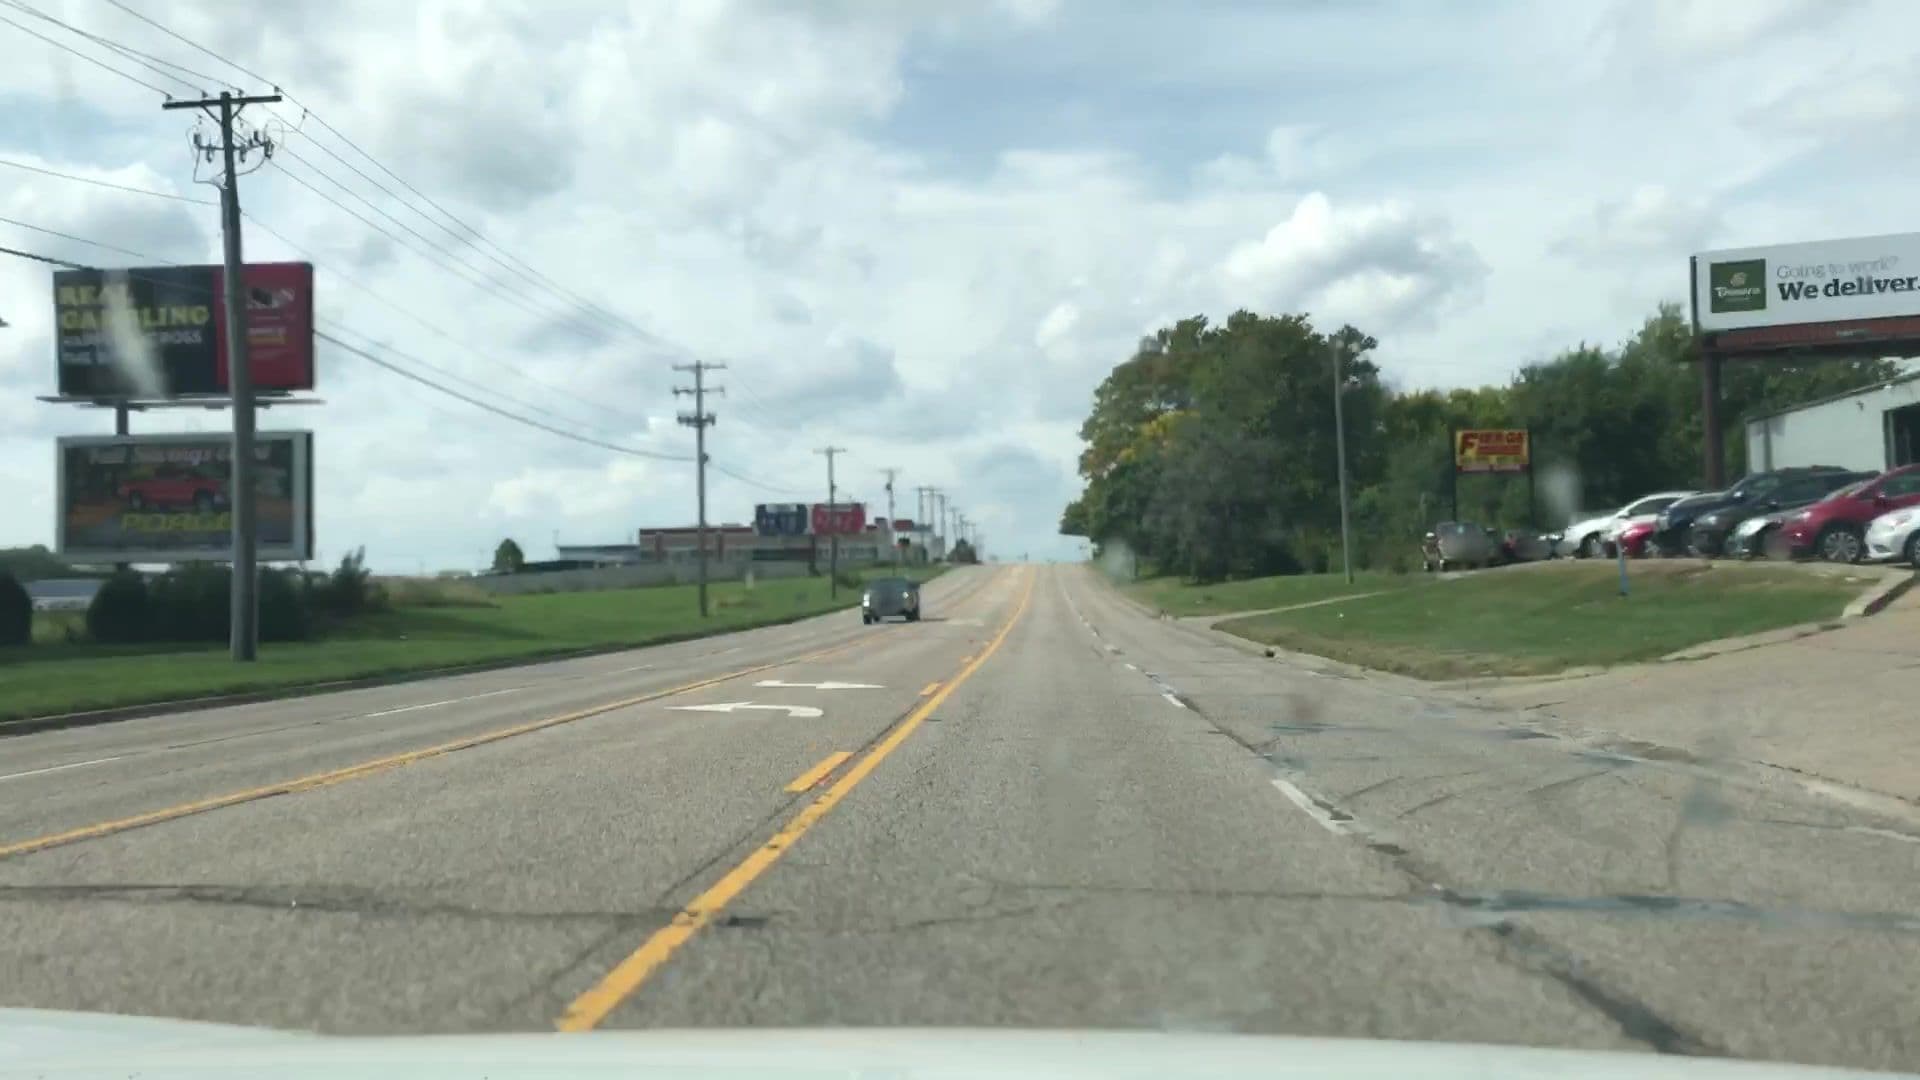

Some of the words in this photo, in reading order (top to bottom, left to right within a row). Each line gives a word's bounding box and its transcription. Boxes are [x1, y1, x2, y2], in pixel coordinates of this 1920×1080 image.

[1777, 264, 1825, 281] Going
[1829, 263, 1845, 275] to
[1849, 256, 1899, 274] work?
[59, 284, 130, 308] REA
[1777, 281, 1819, 301] We
[62, 304, 210, 330] GALING
